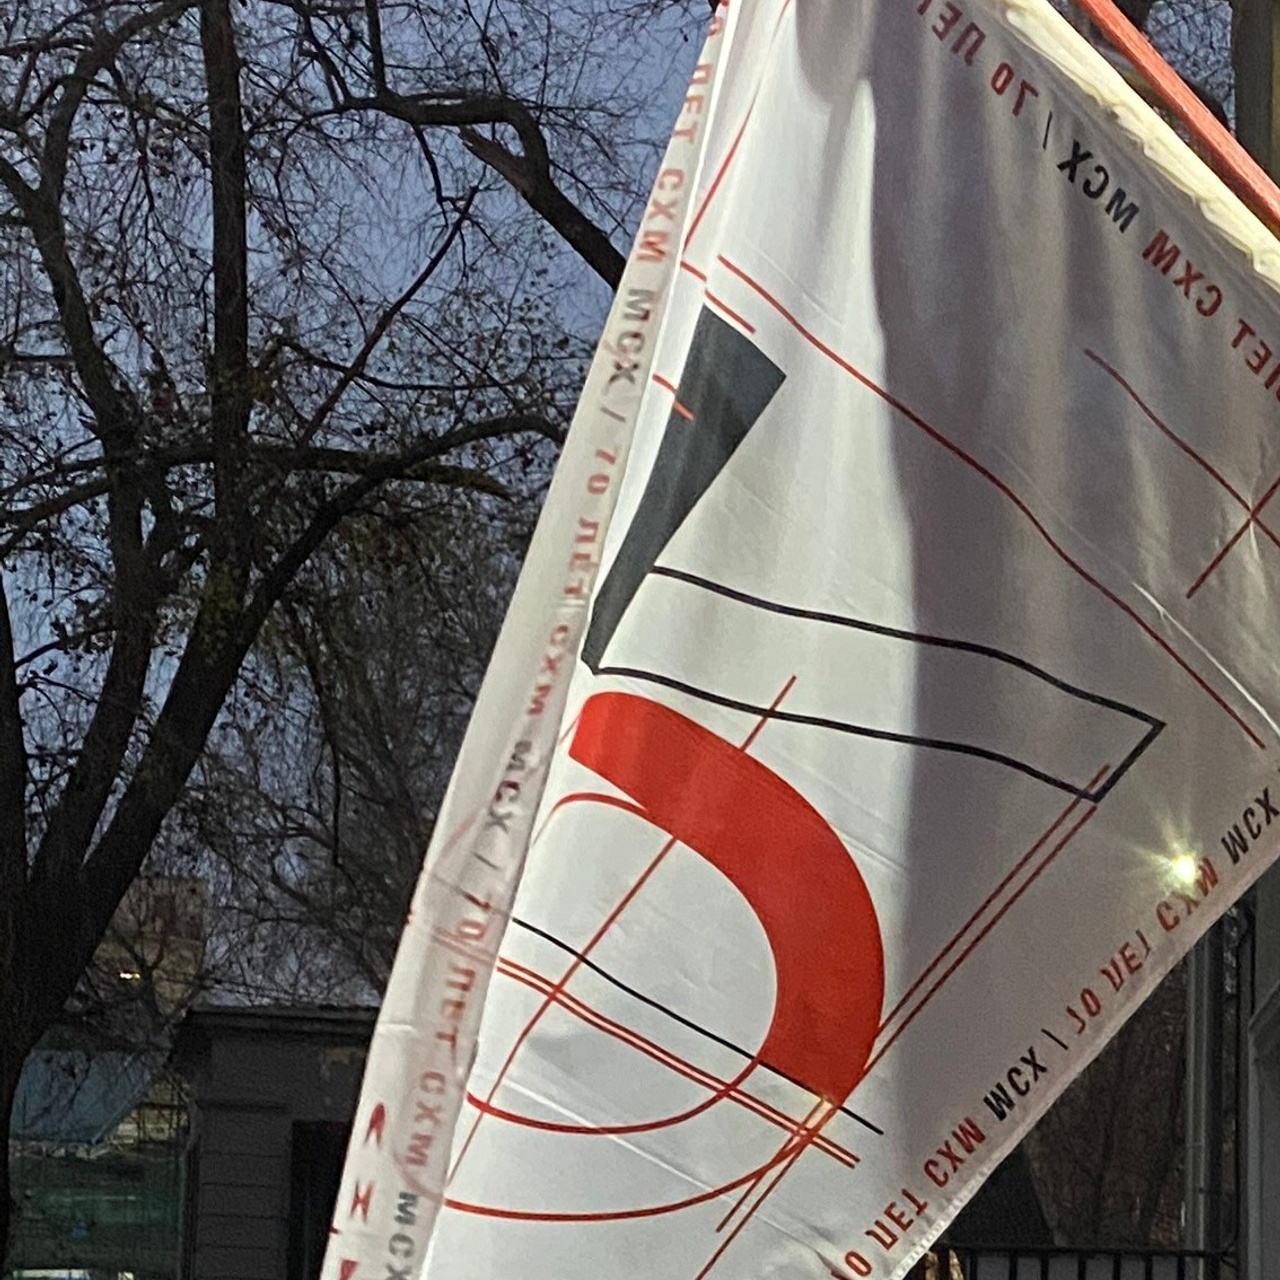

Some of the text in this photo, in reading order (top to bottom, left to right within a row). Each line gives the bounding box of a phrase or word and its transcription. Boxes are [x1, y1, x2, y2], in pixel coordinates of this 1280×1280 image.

[636, 168, 684, 263] СХМ
[604, 288, 656, 396] МСХ
[584, 448, 619, 498] 70
